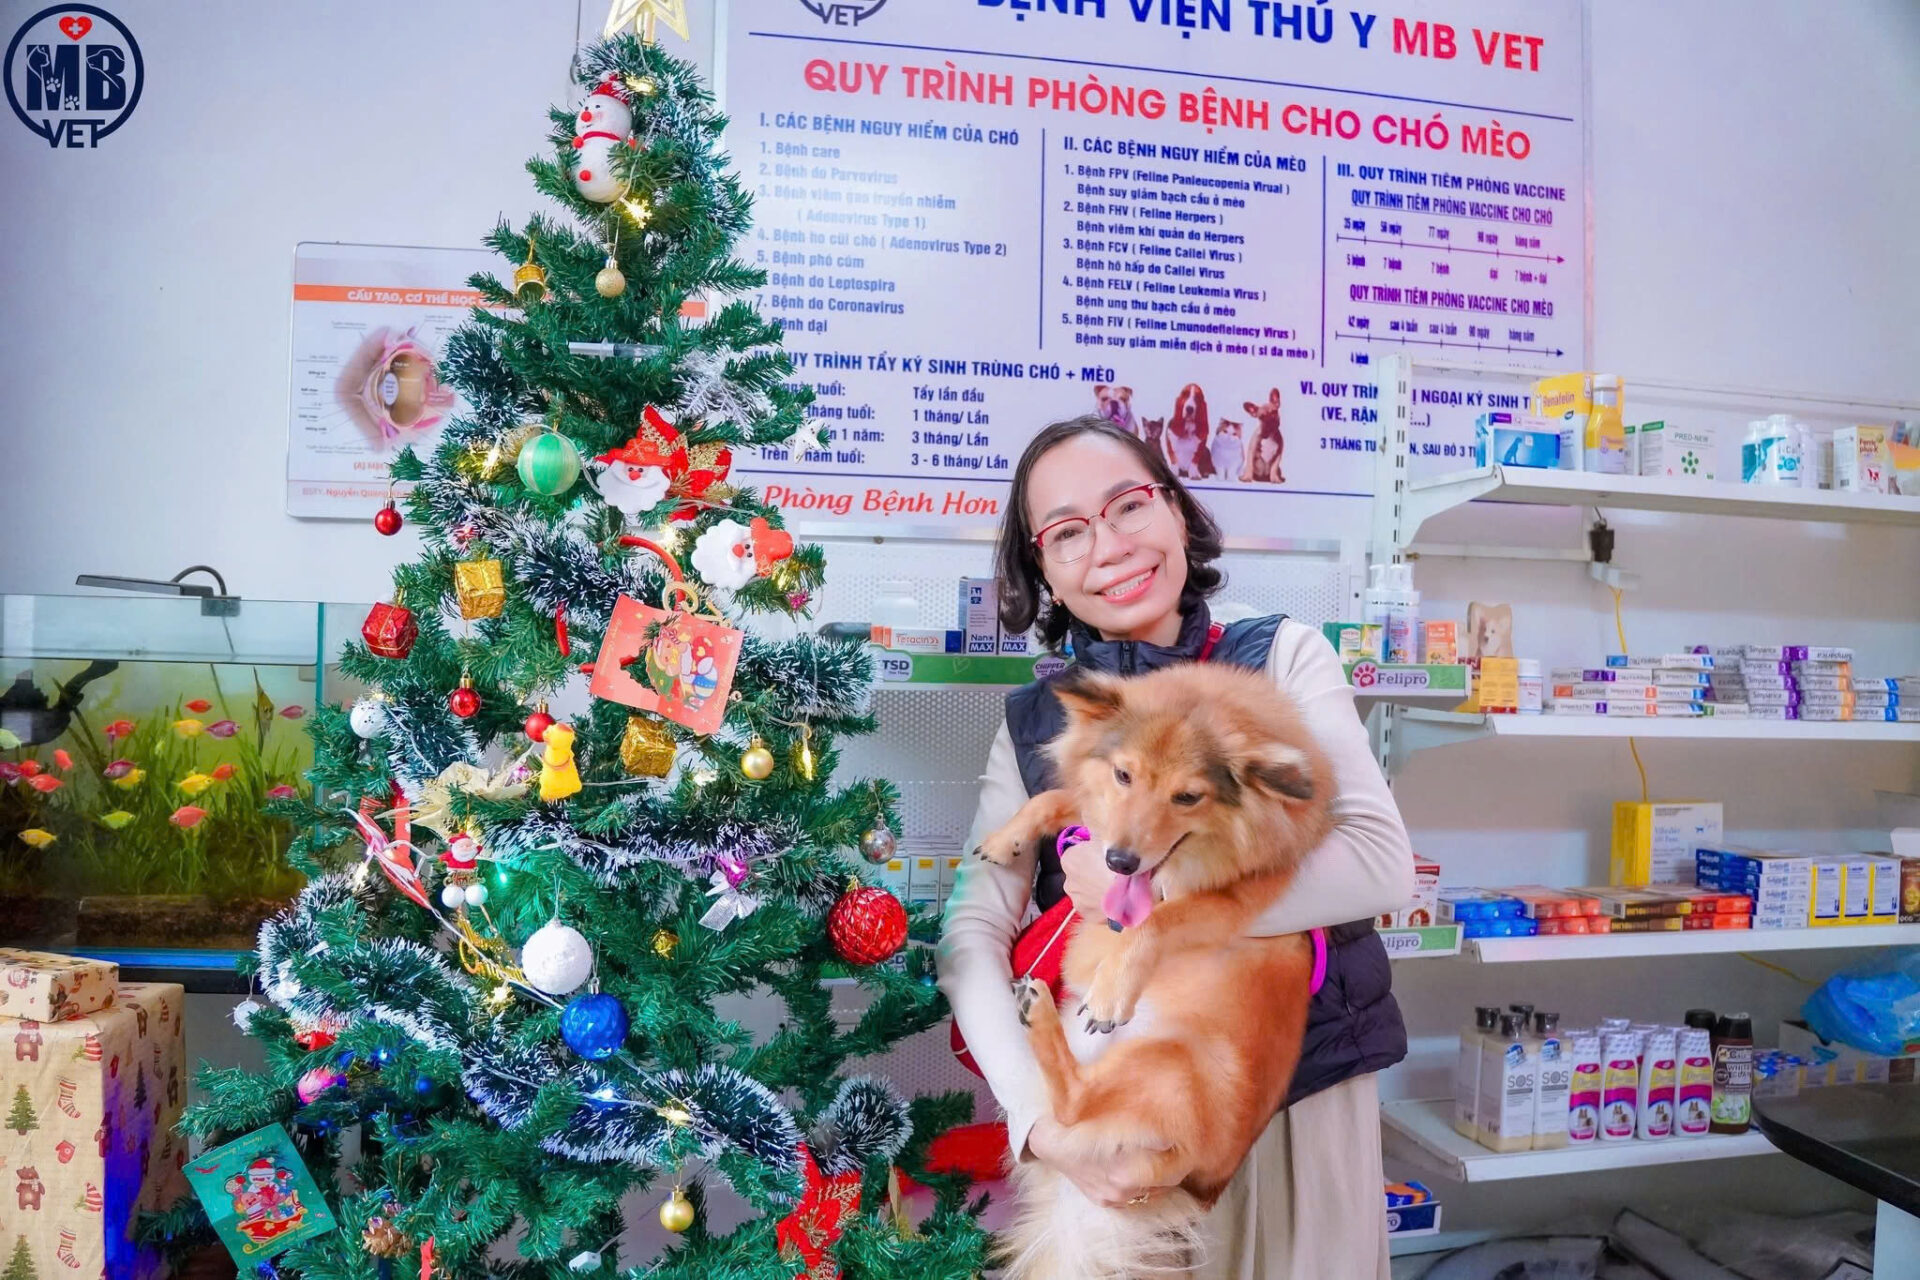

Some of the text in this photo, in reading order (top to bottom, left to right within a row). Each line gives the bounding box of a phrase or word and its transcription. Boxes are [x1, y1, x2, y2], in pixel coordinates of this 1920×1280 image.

[816, 3, 863, 26] VET
[1250, 0, 1333, 43] THÚ
[1350, 12, 1376, 49] Y
[1393, 18, 1456, 60] MB
[1472, 29, 1544, 72] VET
[804, 59, 1530, 159] QUY TRÌNH PHÒNG BỆNH CHO CHÓ MÈO
[761, 112, 1018, 145] I. CÁC BỆNH NGUY HIỂM CỦA CHÓ
[1064, 136, 1305, 172] II. CÁC BỆNH NGUY HIỂM CỦA MÈO
[1337, 163, 1565, 201] III. QUY TRÌNH TIÊM PHÒNG VACCINE
[1077, 202, 1216, 225] Bệnh FHV Feline Herpers
[1352, 189, 1552, 224] QUY TRÌNH TIÊM PHÒNG VACCINE CHO CHÓ
[1077, 239, 1235, 262] Bệnh FCV Feline Virus
[772, 273, 895, 293] Bệnh do Leptospira
[1076, 277, 1259, 300] Bệnh FELV Feline Leukemia Virus
[772, 295, 904, 314] Bệnh do Coronavirus
[1350, 284, 1553, 316] QUY TRÌNH TIÊM PHÒNG VACCINE CHO MÈO
[1076, 314, 1288, 340] Bệnh FIV Feline Virus
[814, 350, 1114, 384] TRÌNH TẨY KÝ SINH TRÙNG CHÓ MÈO
[913, 385, 936, 403] Tẩy
[1300, 381, 1348, 398] VI. QUY
[1421, 390, 1518, 409] NGOẠI KÝ SINH
[924, 409, 964, 427] tháng/
[924, 433, 964, 449] tháng/
[1320, 438, 1362, 451] 3 THÁNG
[1423, 442, 1456, 457] SAU ĐÓ
[944, 454, 983, 472] tháng/
[763, 485, 998, 517] Phòng Bệnh Hơn
[970, 643, 993, 651] MAX
[1003, 643, 1026, 651] MAX
[883, 660, 909, 670] TSD
[1377, 673, 1427, 688] Felipro
